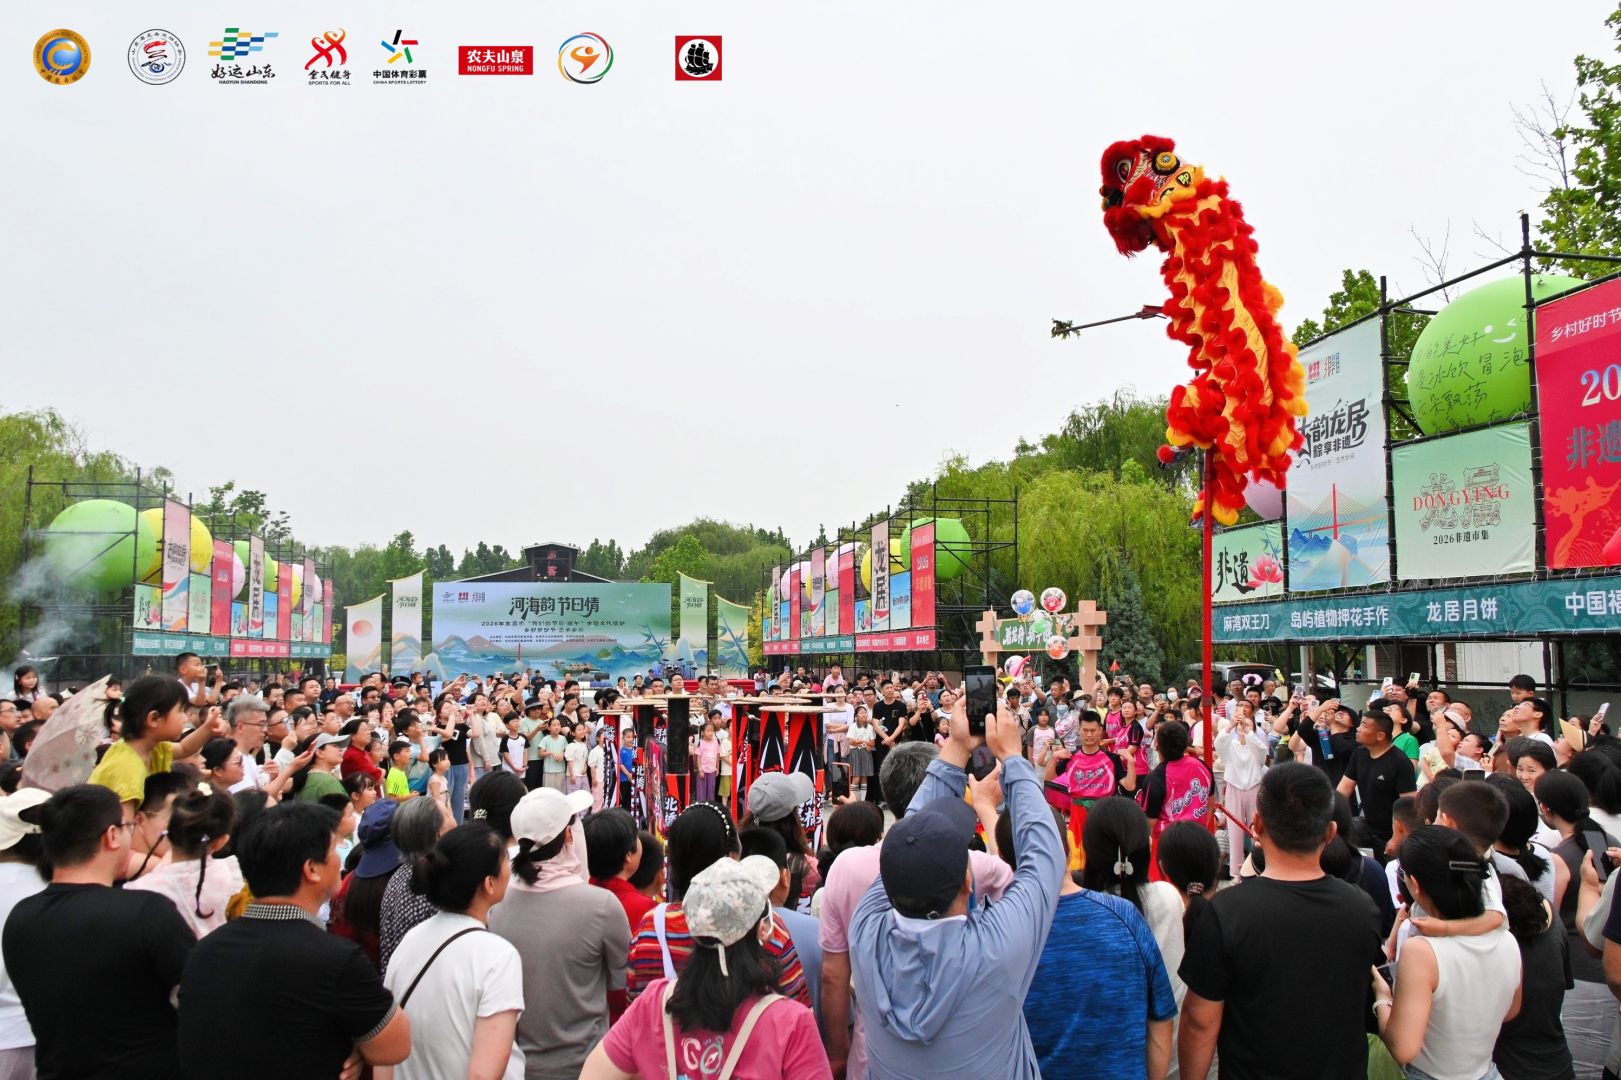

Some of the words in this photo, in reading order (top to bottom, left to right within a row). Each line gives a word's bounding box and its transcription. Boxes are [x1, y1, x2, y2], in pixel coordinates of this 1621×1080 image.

[1312, 434, 1352, 459] 粽享非遗
[1566, 420, 1621, 472] 非遗
[1413, 483, 1511, 512] DONGYING
[1433, 529, 1490, 545] 2026非遗市集
[1213, 547, 1256, 595] 非遗
[508, 596, 600, 621] 河海韵节日情
[1290, 605, 1389, 629] 岛屿植物押花手作
[1426, 597, 1499, 623] 龙居月饼
[1223, 613, 1270, 632] 麻湾双王刀
